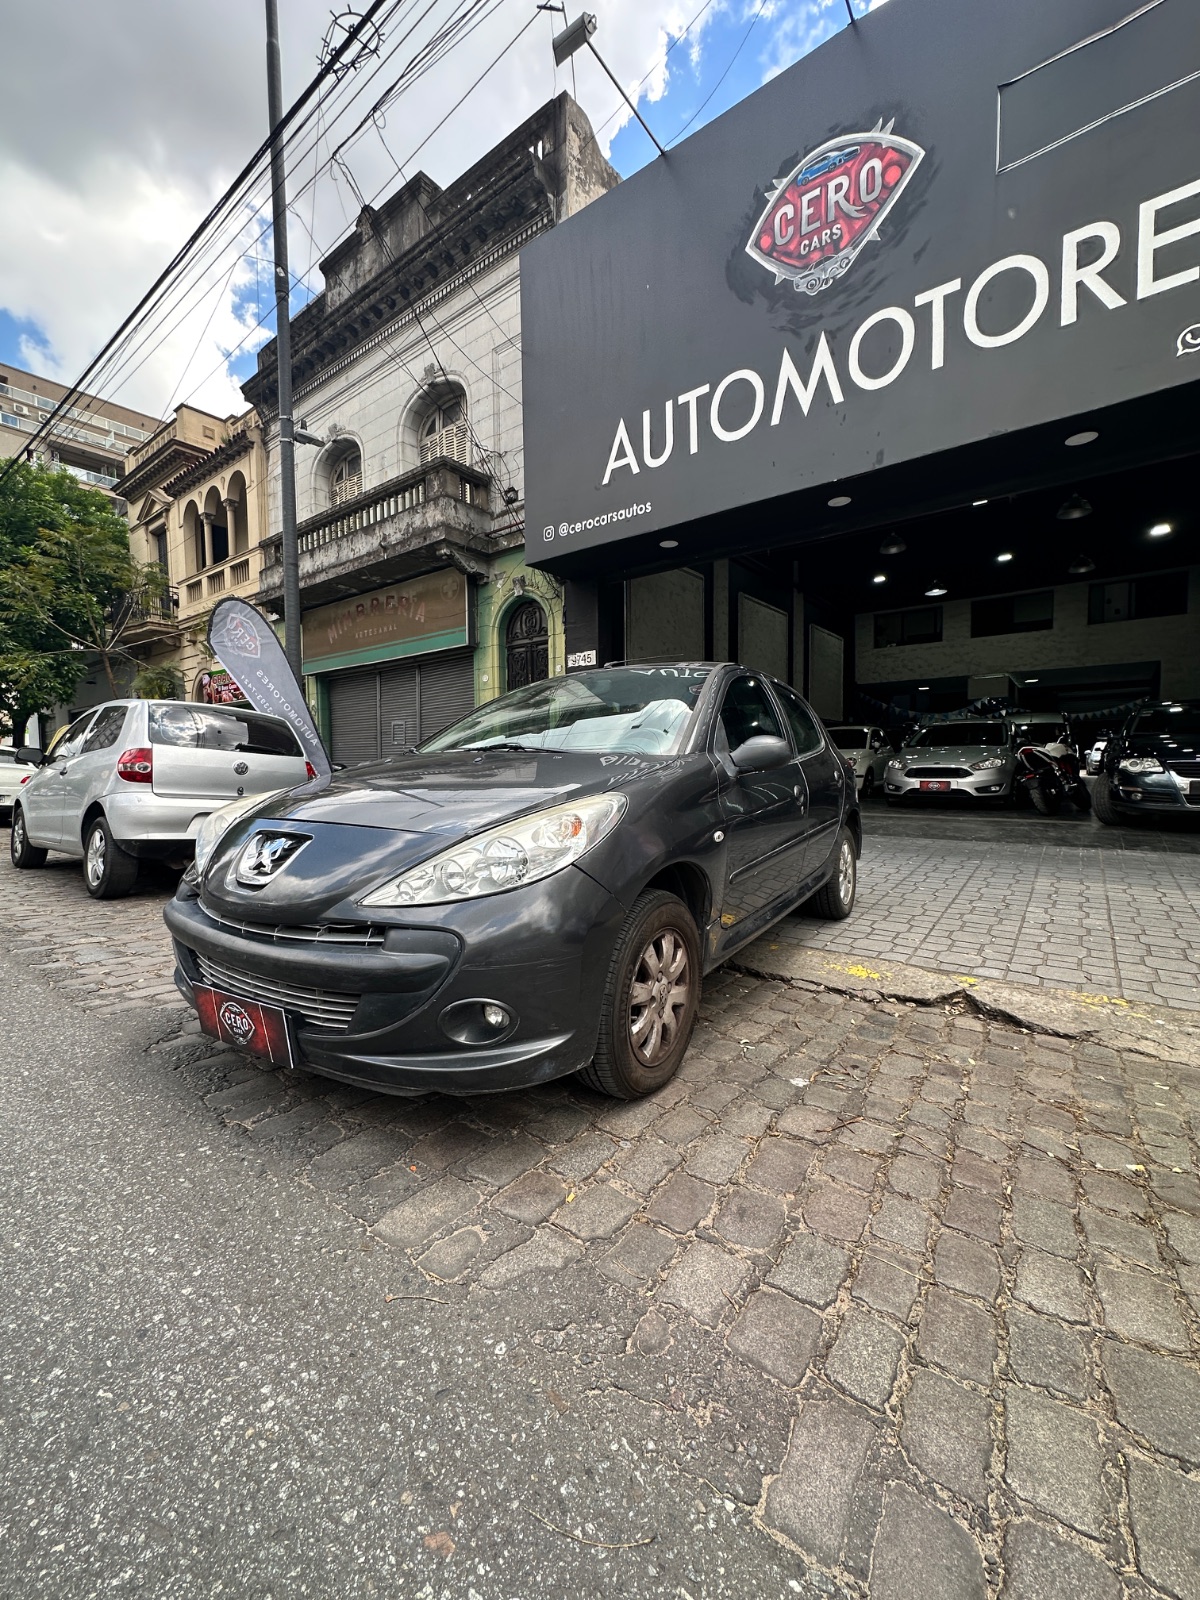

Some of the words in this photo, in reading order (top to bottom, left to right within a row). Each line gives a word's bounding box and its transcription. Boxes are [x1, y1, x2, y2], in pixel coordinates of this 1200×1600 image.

[774, 157, 883, 246] CERO
[800, 223, 842, 255] CARS
[558, 502, 652, 537] @cerocarsautos
[571, 653, 592, 666] 9745
[225, 1012, 248, 1032] CERO
